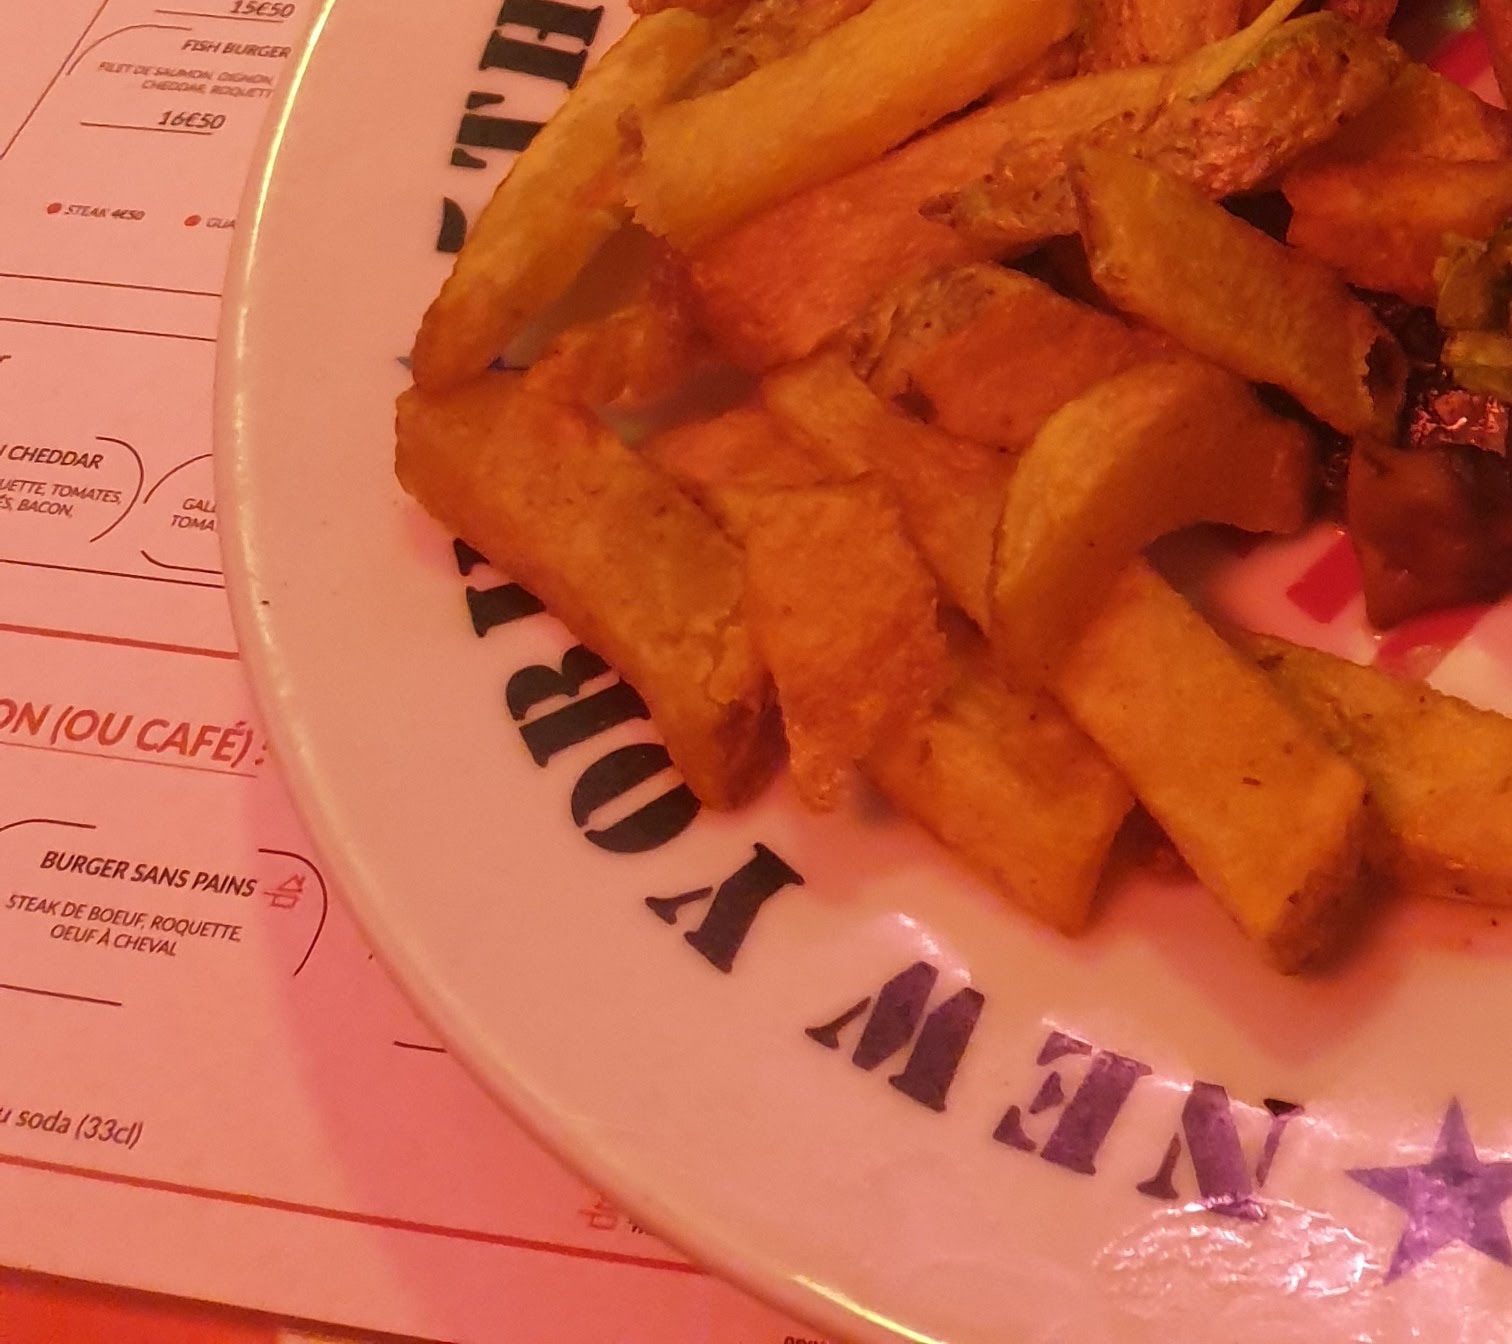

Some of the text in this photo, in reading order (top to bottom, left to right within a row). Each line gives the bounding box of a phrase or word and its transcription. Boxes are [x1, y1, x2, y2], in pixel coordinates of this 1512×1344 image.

[229, 0, 296, 19] 15€50
[181, 38, 293, 59] FISH BURGER
[157, 109, 227, 130] 16€50
[7, 444, 105, 470] CHEDDAR
[16, 498, 75, 519] BACON,
[50, 483, 123, 506] TOMATES,
[50, 704, 134, 747] (OU
[39, 849, 259, 899] BURGER SANS PAINS
[5, 893, 244, 943] STEAK DE BOEUF, ROQUETTE
[49, 923, 178, 958] OEUF À CHEVAL
[804, 959, 1305, 1222] NEW
[15, 1109, 72, 1135] soda
[74, 1113, 144, 1151] (33cl)
